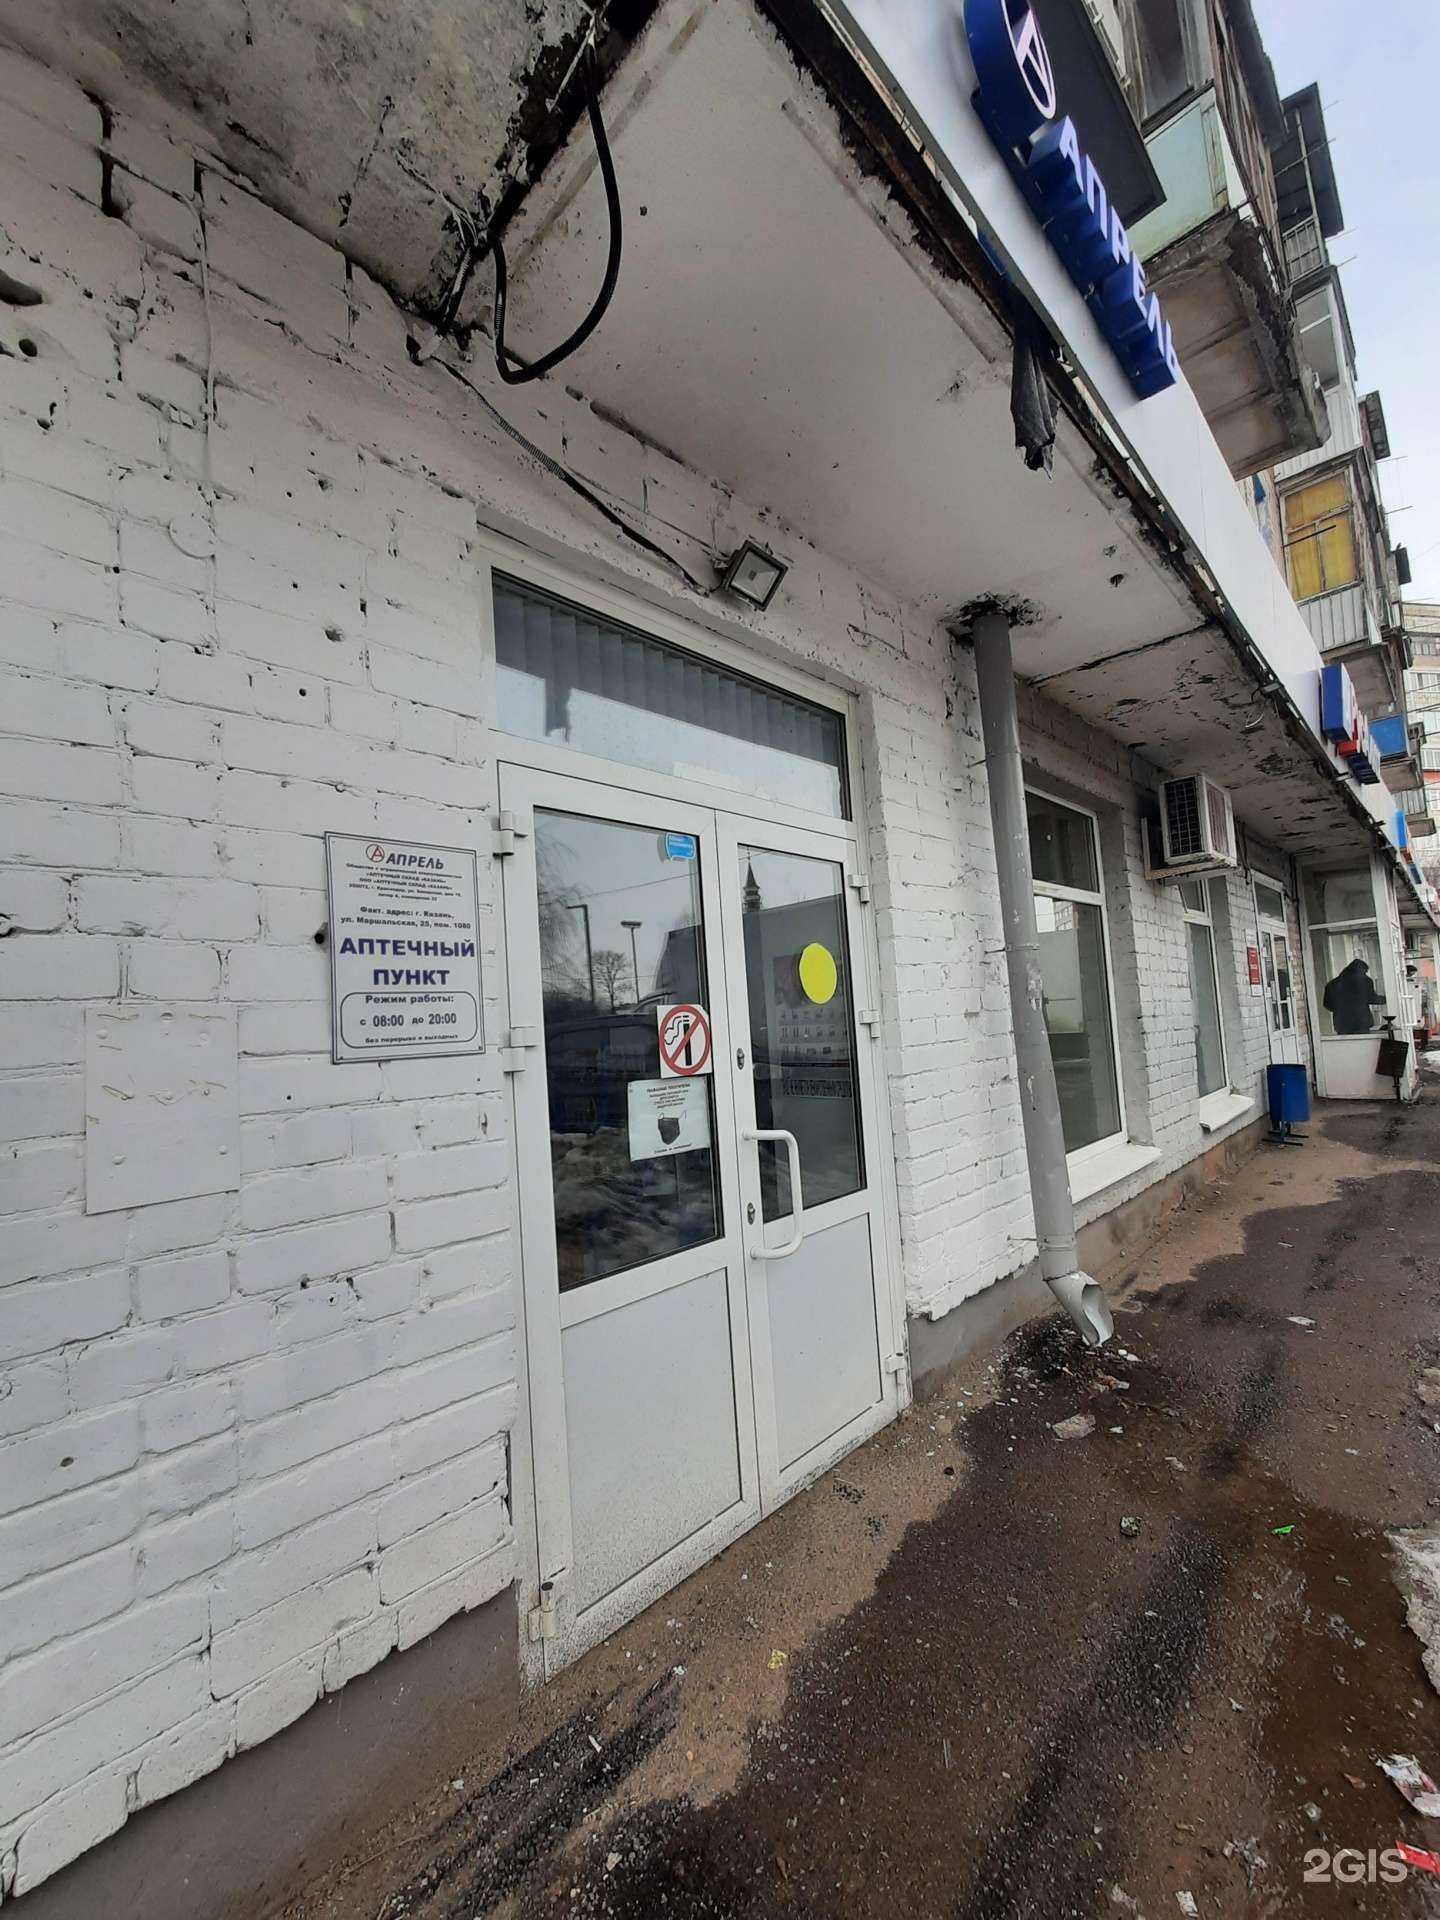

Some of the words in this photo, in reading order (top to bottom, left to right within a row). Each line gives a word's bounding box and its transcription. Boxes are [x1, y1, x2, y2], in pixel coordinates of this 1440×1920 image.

[1058, 114, 1178, 384] АПРЕЛЬ
[386, 852, 445, 870] АПРЕЛЬ
[360, 906, 384, 915] Факт.
[386, 908, 414, 917] адрес:
[340, 916, 355, 924] ул.
[339, 937, 475, 958] АПТЕЧНЫЙ
[373, 968, 450, 985] ПУНКТ
[365, 995, 407, 1004] Режим
[410, 994, 455, 1005] работы:
[360, 1018, 367, 1026] с
[373, 1014, 405, 1027] 08:00
[411, 1017, 425, 1025] до
[428, 1013, 457, 1025] 20:00
